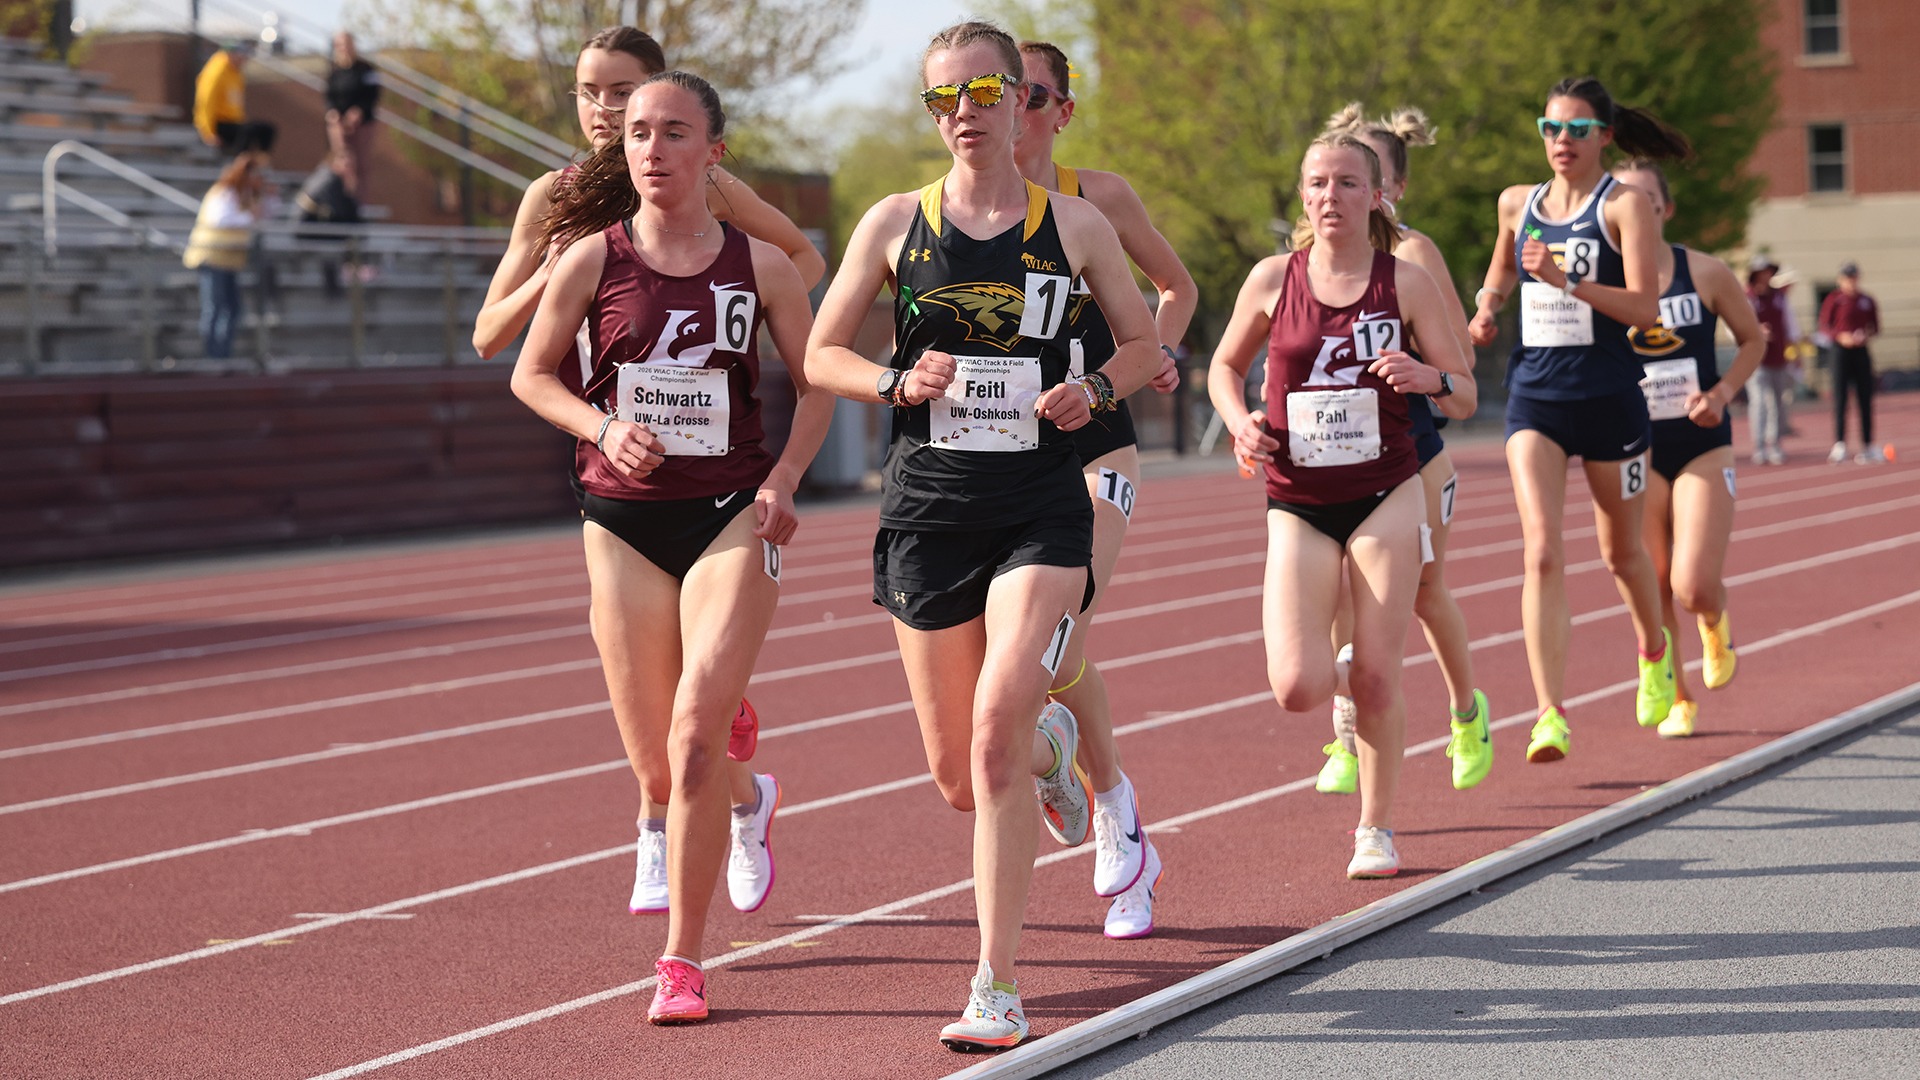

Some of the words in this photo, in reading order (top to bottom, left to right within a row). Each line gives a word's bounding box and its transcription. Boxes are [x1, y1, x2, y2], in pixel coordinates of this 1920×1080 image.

[1024, 258, 1057, 272] WIAC
[1573, 242, 1591, 277] 8
[1037, 279, 1058, 336] 1
[1663, 298, 1694, 324] 10
[725, 294, 748, 350] 6
[1357, 322, 1394, 358] 12
[650, 375, 697, 384] Championships
[961, 366, 1011, 375] Championships
[634, 386, 712, 407] Schwartz
[965, 380, 1006, 399] Feitl
[634, 412, 670, 426] UW-La
[673, 414, 710, 426] Crosse
[950, 406, 1020, 420] UW-Oshkosh
[1316, 408, 1347, 424] Pahl
[1333, 430, 1364, 440] Crosse
[1627, 462, 1641, 493] 8
[1103, 470, 1134, 518] 16
[1443, 479, 1456, 518] 7
[1051, 617, 1070, 671] 1
